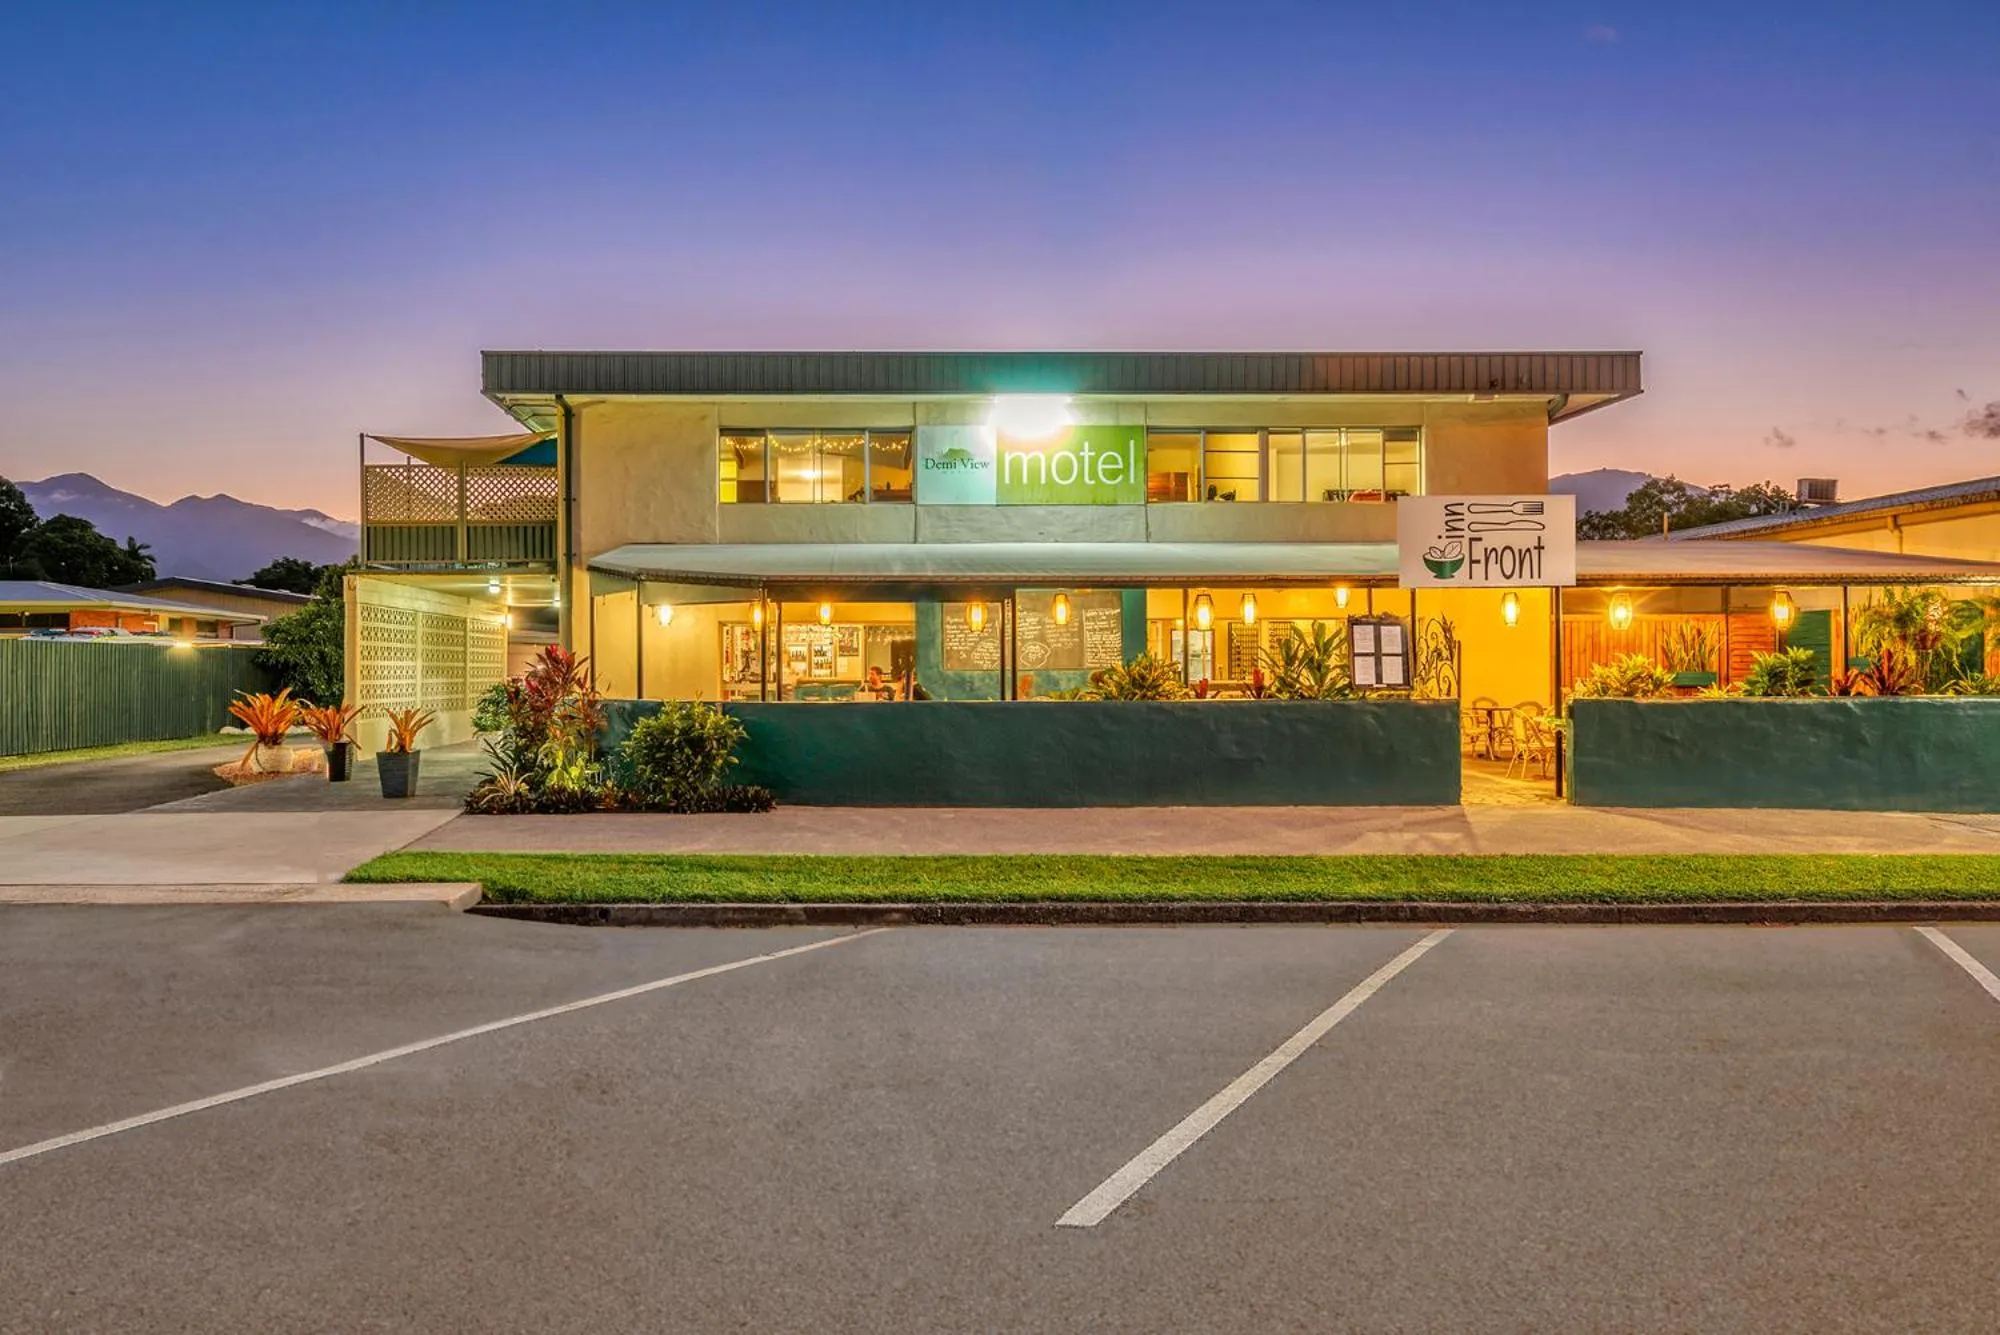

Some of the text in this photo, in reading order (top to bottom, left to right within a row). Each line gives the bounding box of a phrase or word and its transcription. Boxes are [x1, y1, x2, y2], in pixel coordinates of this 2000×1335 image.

[924, 457, 990, 470] Demi View
[1004, 439, 1136, 485] motel
[1437, 502, 1465, 539] inn
[1468, 536, 1545, 580] Front
